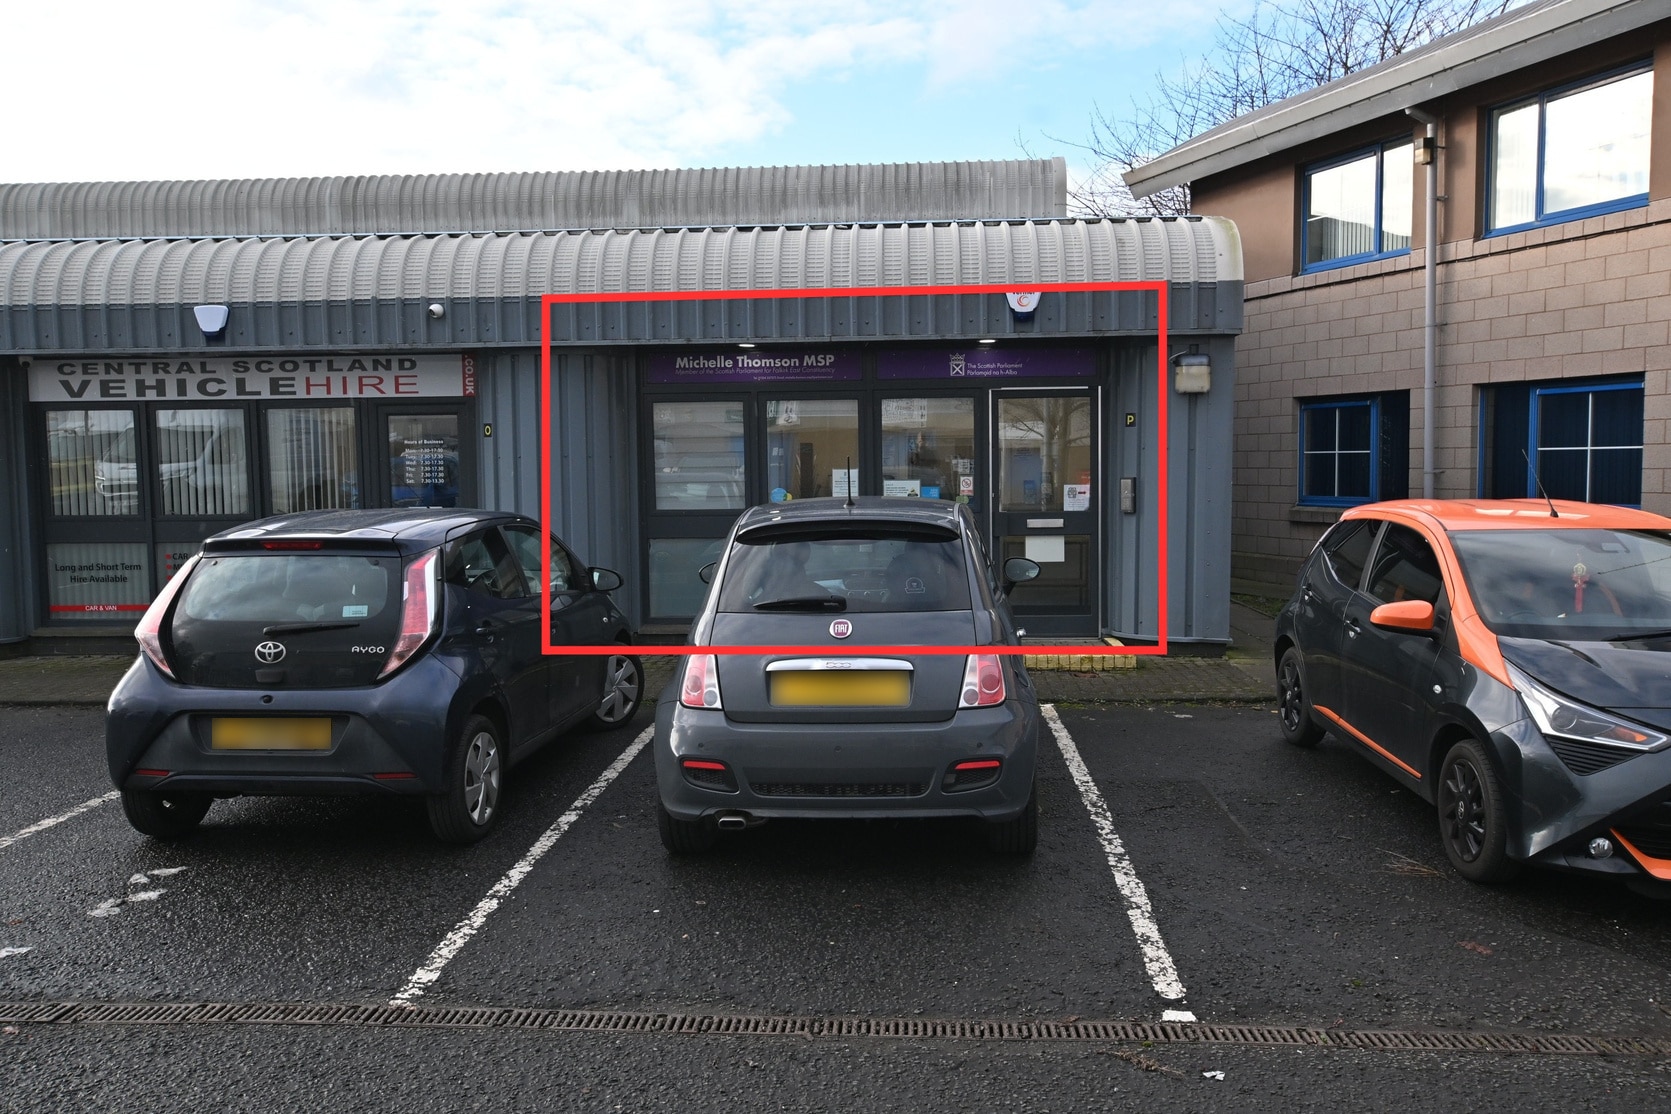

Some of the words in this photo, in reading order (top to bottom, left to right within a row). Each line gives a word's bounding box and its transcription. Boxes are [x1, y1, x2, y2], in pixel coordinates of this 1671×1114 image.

[675, 355, 733, 368] Michelle
[736, 355, 799, 367] Thomson
[803, 354, 835, 366] MSP
[57, 361, 217, 376] CENTRAL
[232, 358, 417, 374] SCOTLAND
[1127, 415, 1134, 425] P
[54, 563, 77, 573] Long
[78, 563, 93, 571] and
[96, 562, 119, 571] Short
[120, 562, 142, 571] Term
[70, 575, 88, 583] Hire
[89, 574, 128, 583] Available
[834, 624, 849, 633] FIAT
[351, 645, 385, 654] AYGO
